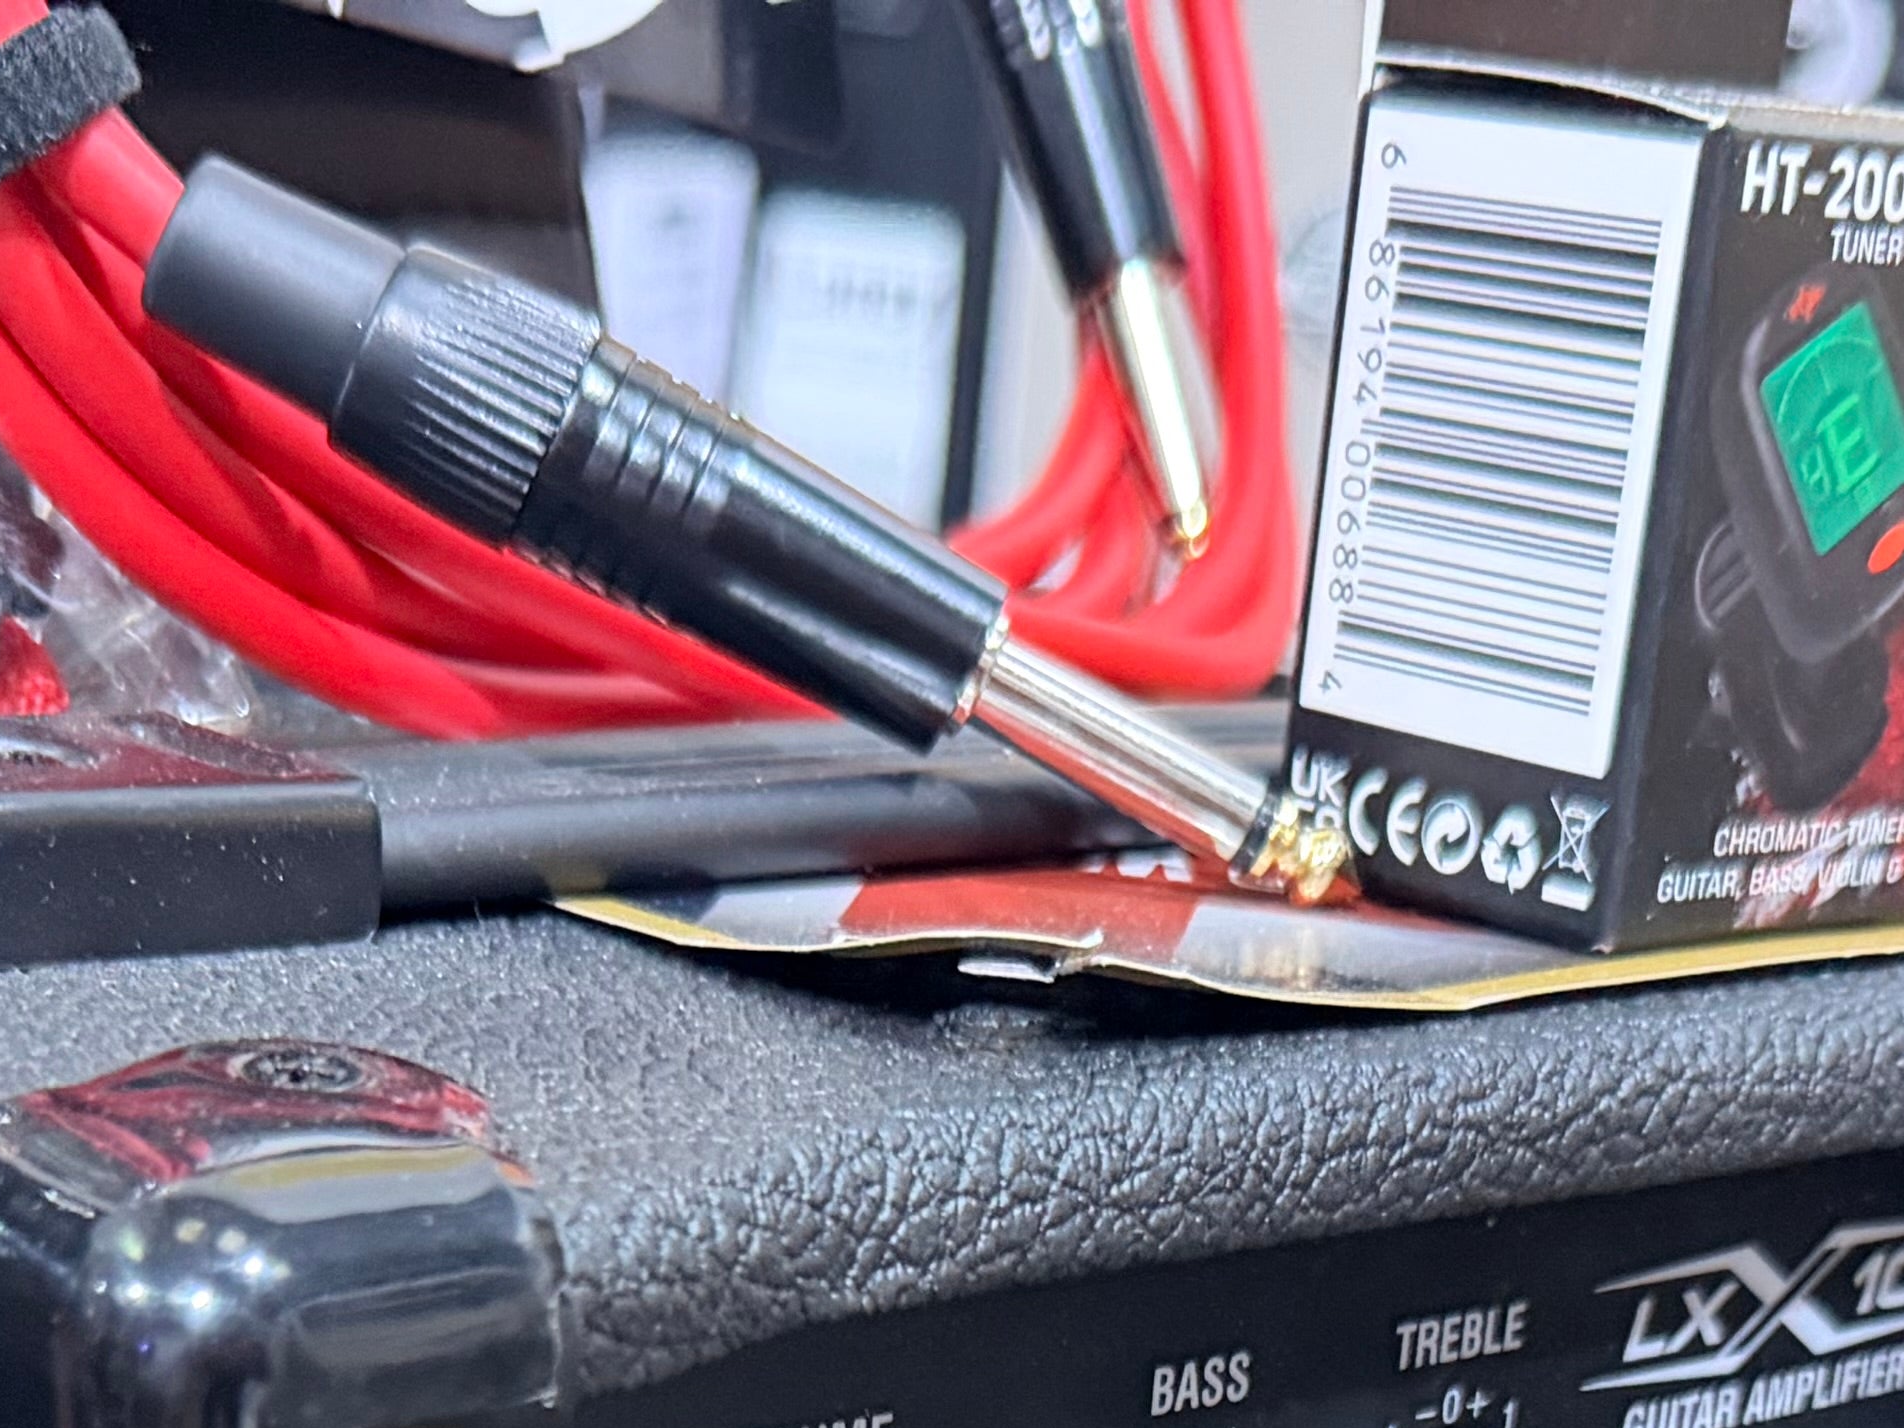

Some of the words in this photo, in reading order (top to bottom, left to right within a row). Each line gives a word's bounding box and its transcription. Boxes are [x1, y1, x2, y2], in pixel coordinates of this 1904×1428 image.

[1380, 141, 1407, 170] 6
[1712, 820, 1844, 858] CHROMATIC
[1656, 870, 1745, 904] GUITAR,
[1817, 855, 1880, 889] VIOLIN
[1396, 1302, 1529, 1371] TREBLE
[1151, 1351, 1252, 1417] BASS
